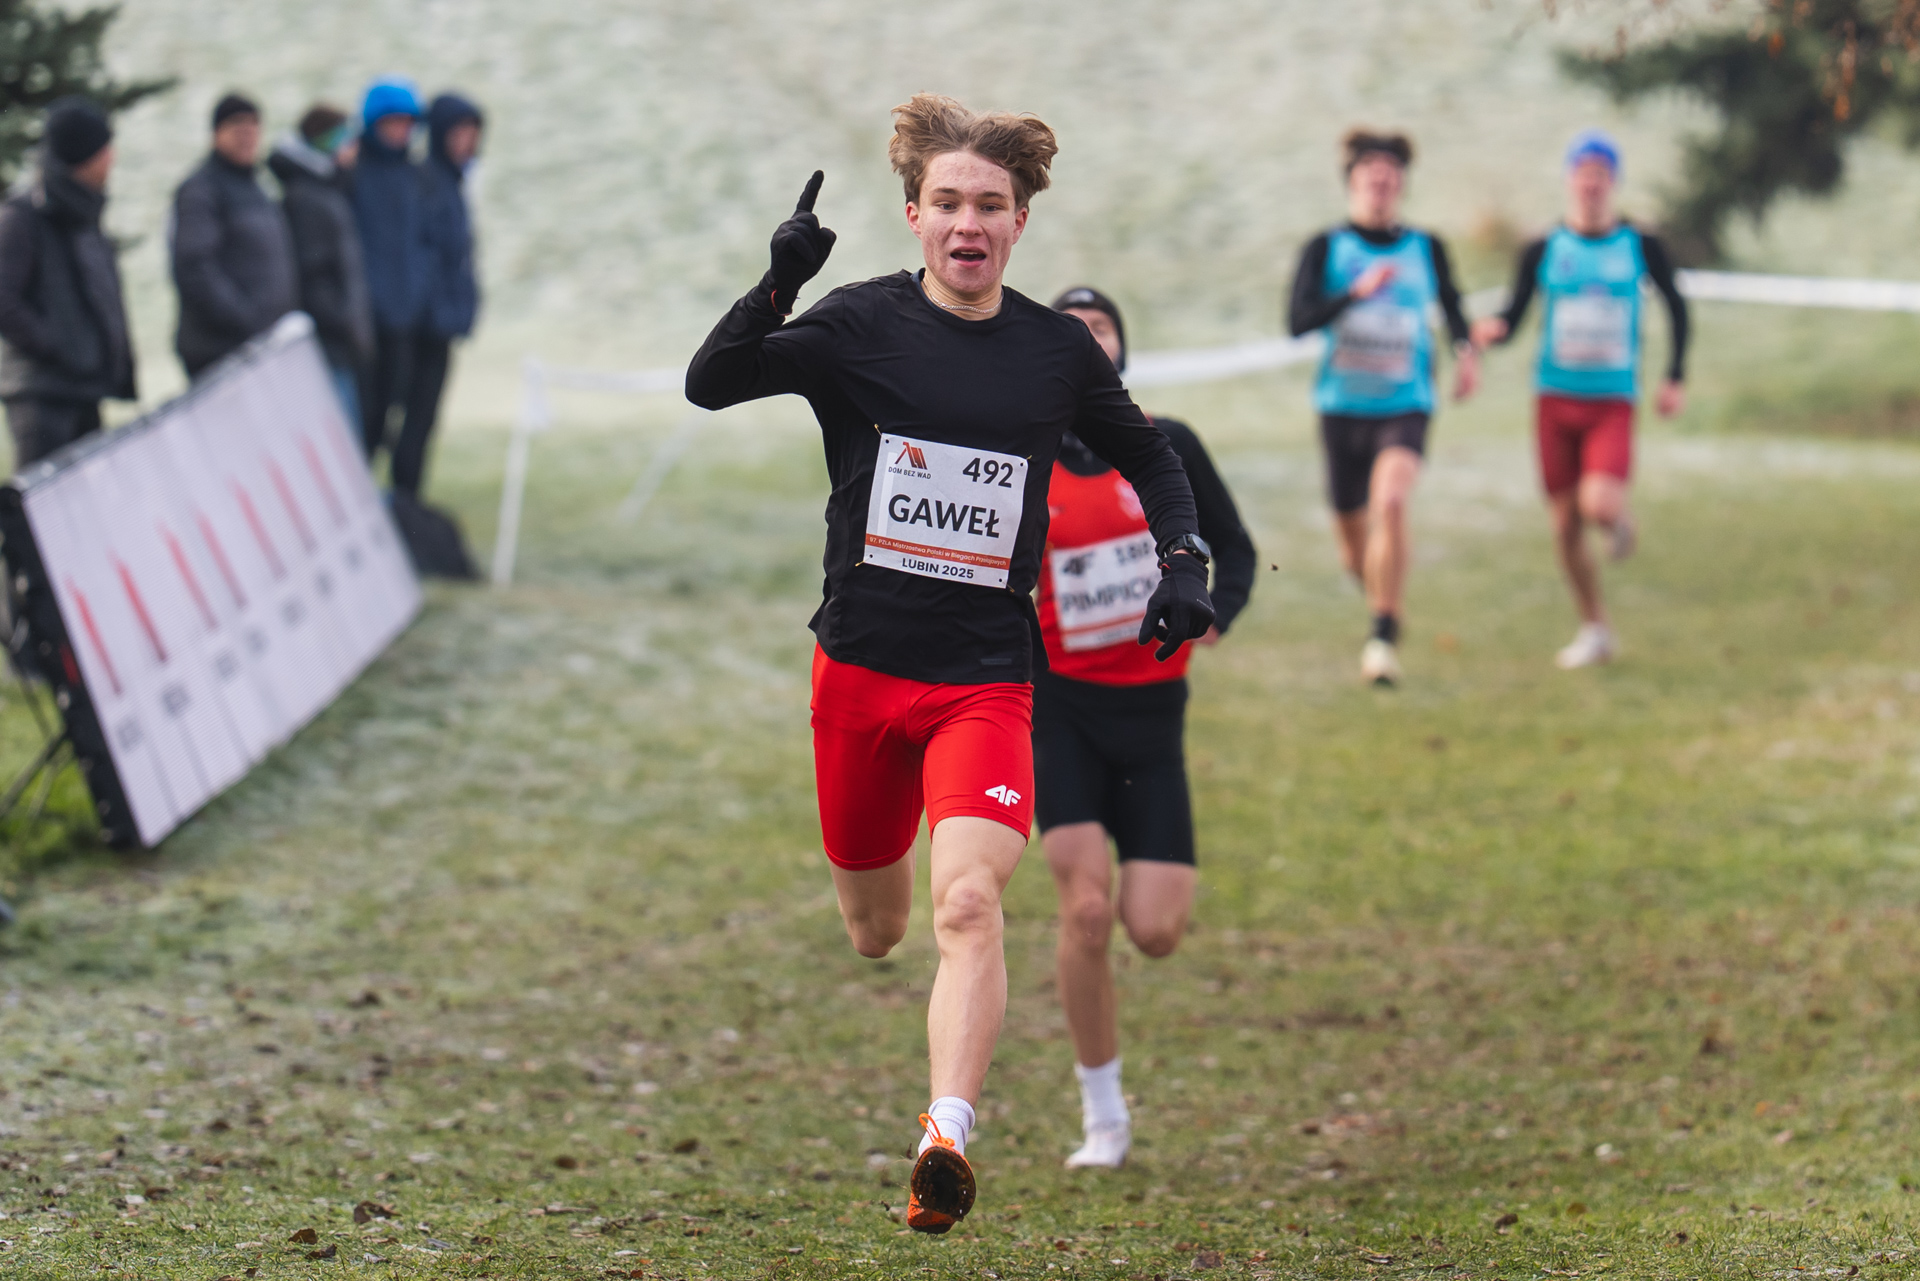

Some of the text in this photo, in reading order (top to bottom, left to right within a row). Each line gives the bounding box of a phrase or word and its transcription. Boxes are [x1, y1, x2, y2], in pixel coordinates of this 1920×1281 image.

[888, 466, 902, 474] DOM
[963, 458, 1014, 488] 492
[888, 494, 1000, 538] GAWEŁ
[879, 538, 891, 546] PZLA
[893, 542, 926, 553] Mistrzostwa
[927, 548, 944, 556] Polski
[951, 552, 975, 562] Biegach
[902, 557, 974, 579] LUBIN 2025
[984, 784, 1022, 807] 4F
